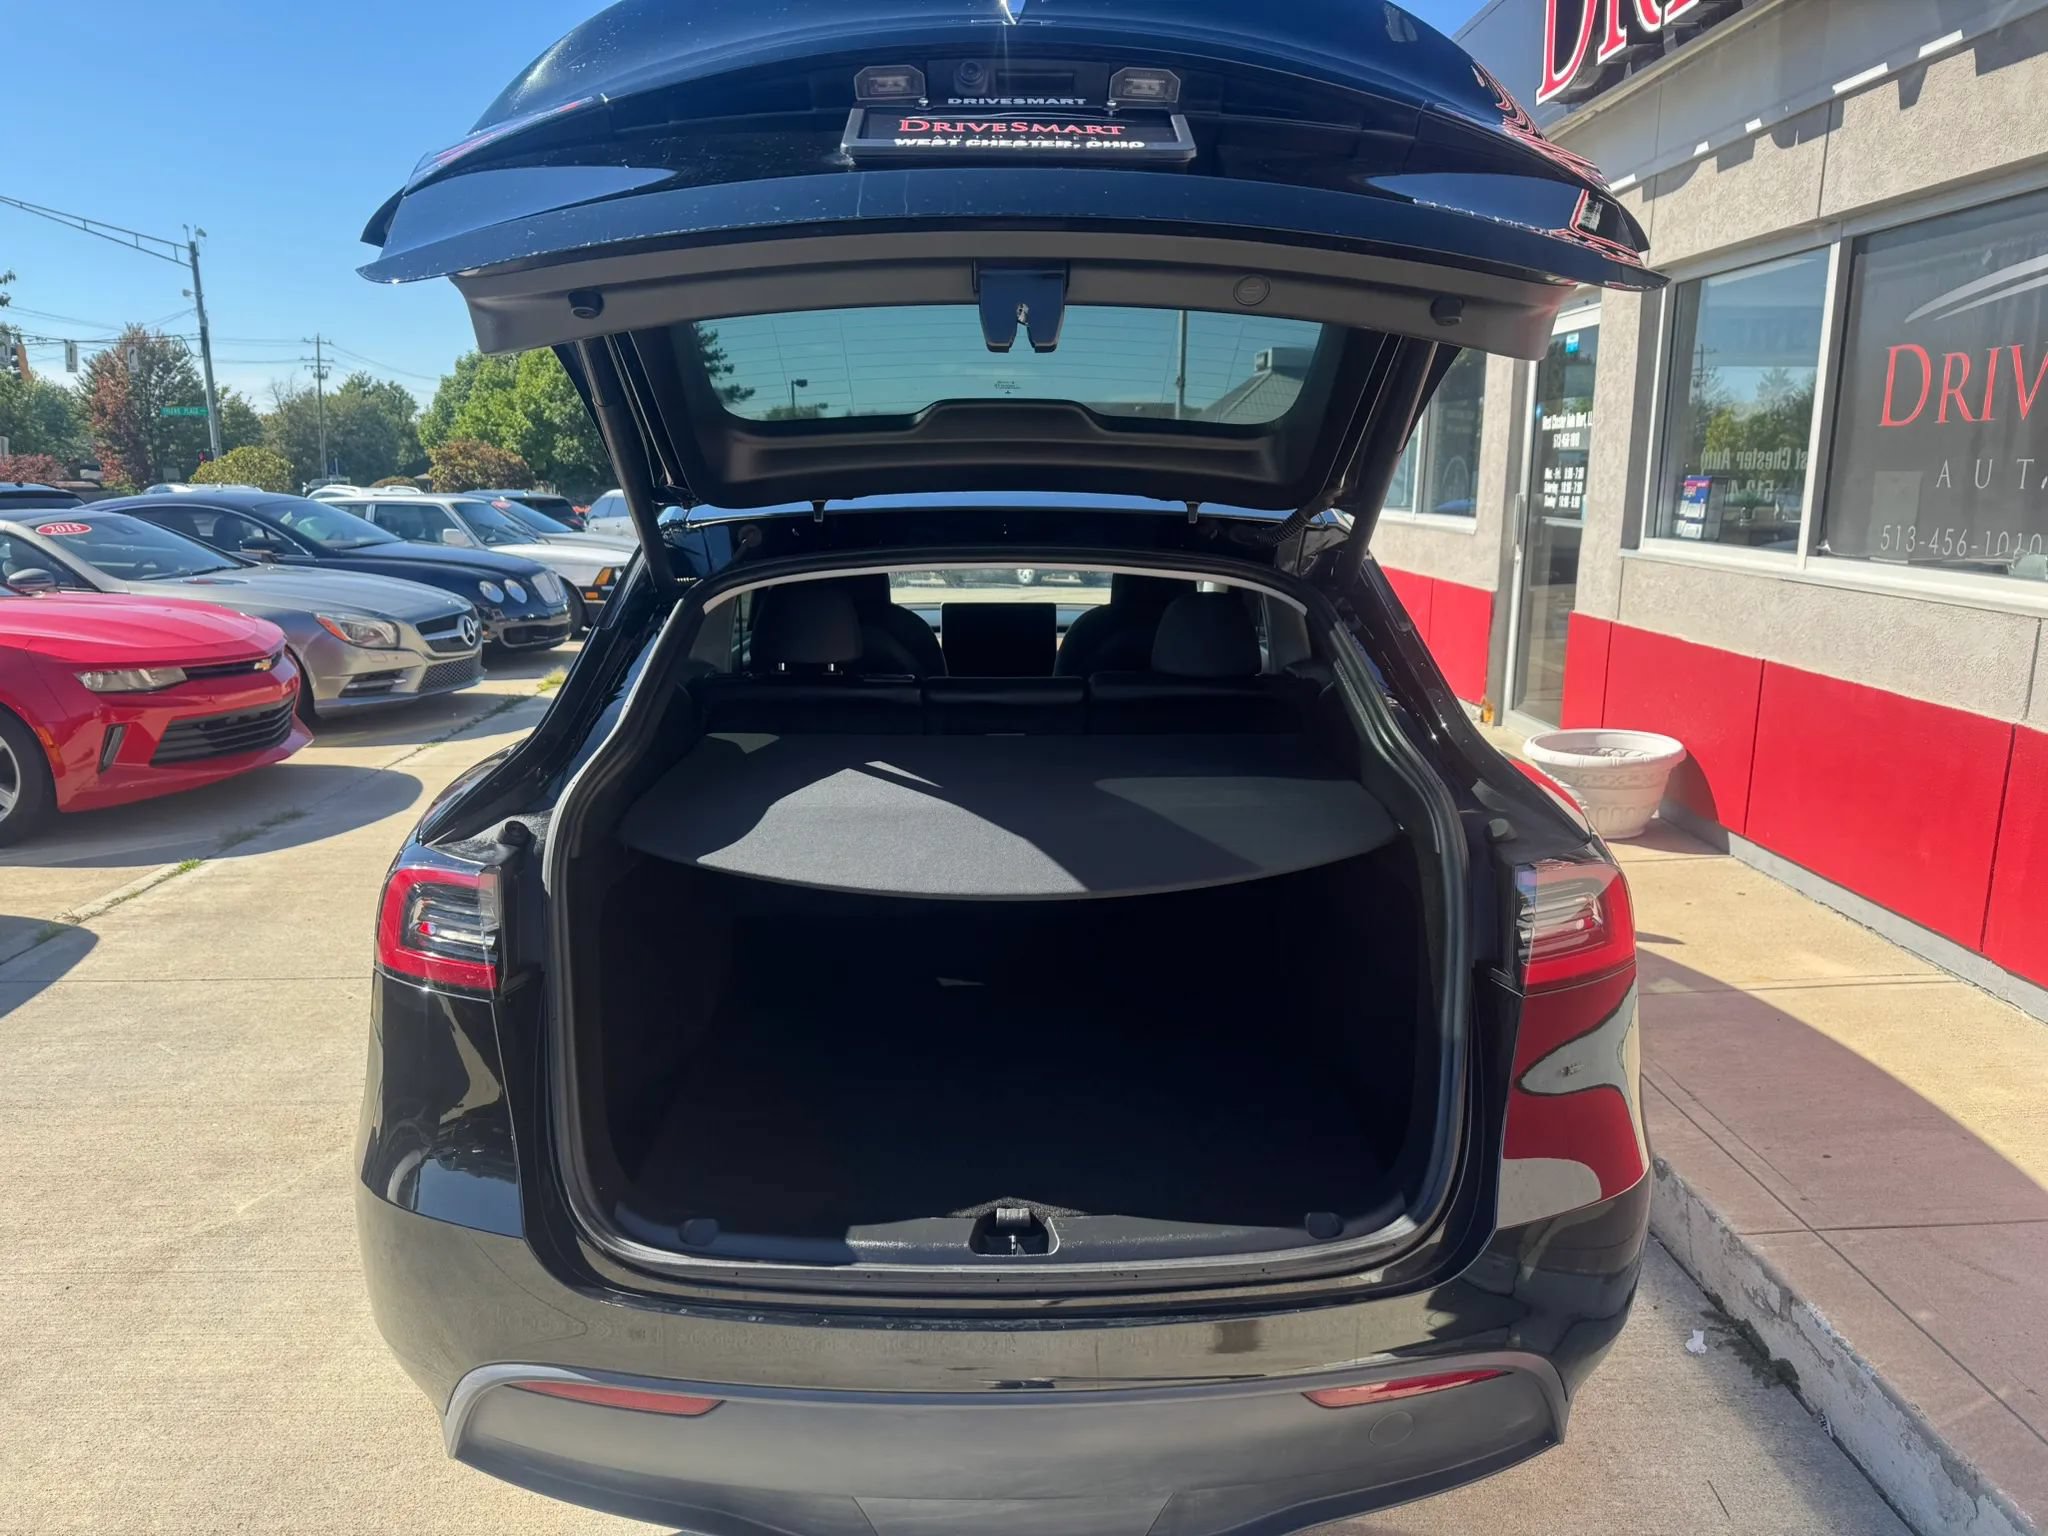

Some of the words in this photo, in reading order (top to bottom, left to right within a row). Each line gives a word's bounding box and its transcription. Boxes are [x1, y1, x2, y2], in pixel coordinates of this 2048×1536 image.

[894, 138, 962, 147] WEST
[965, 139, 1081, 149] CHESTER,
[1086, 140, 1145, 149] OHIO
[47, 524, 82, 535] 2015
[1880, 525, 2042, 557] 513-456-1010
